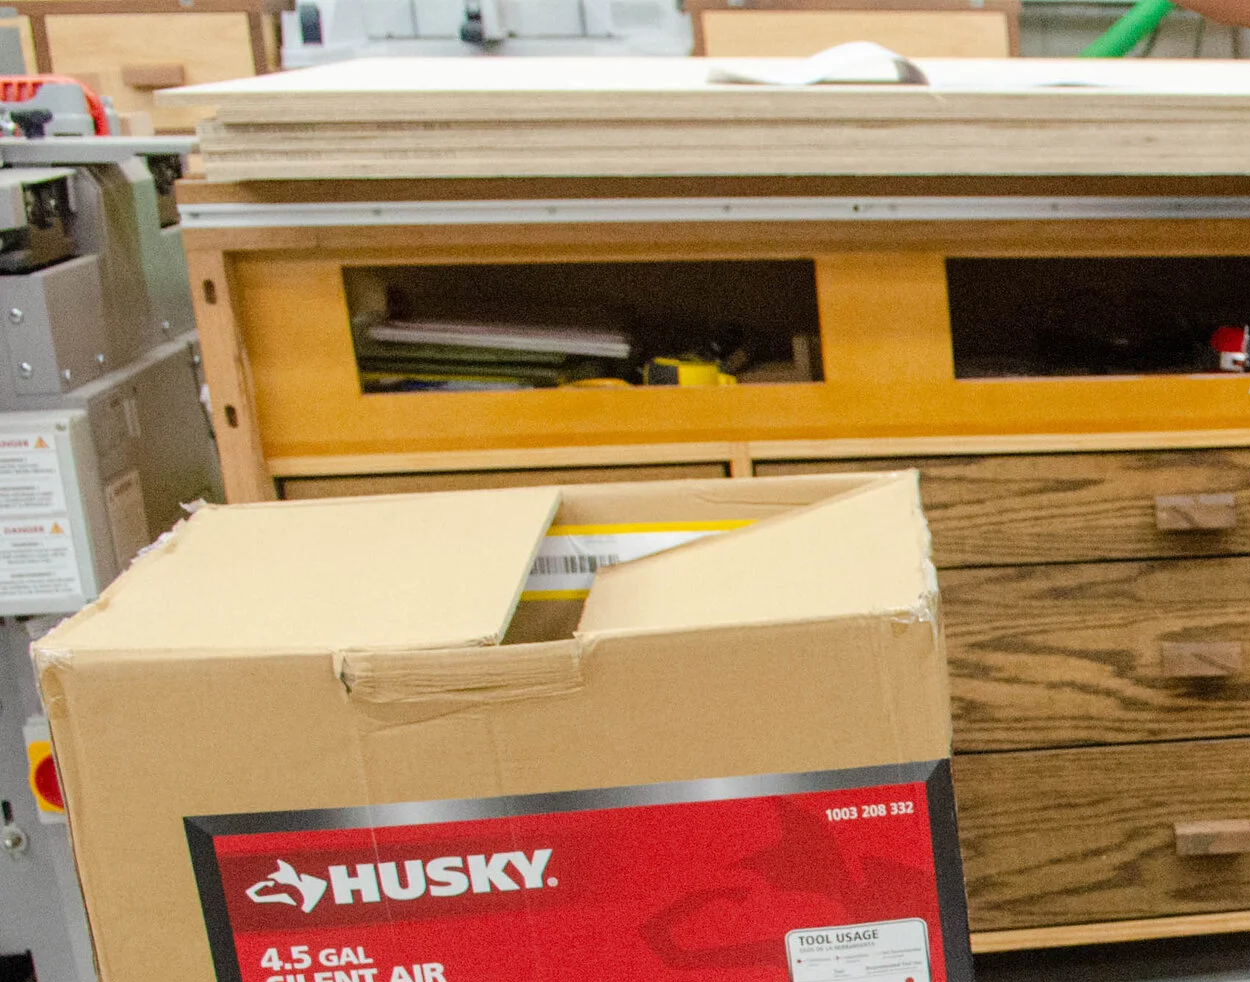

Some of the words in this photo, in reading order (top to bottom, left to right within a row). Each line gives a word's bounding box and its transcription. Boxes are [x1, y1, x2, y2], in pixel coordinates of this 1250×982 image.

[825, 806, 858, 821] 1003
[861, 804, 887, 818] 208
[889, 801, 914, 815] 332
[327, 848, 554, 905] HUSKY
[798, 935, 834, 946] TOOL
[836, 929, 880, 944] USAGE
[260, 945, 311, 970] 4.5
[318, 946, 374, 967] GAL
